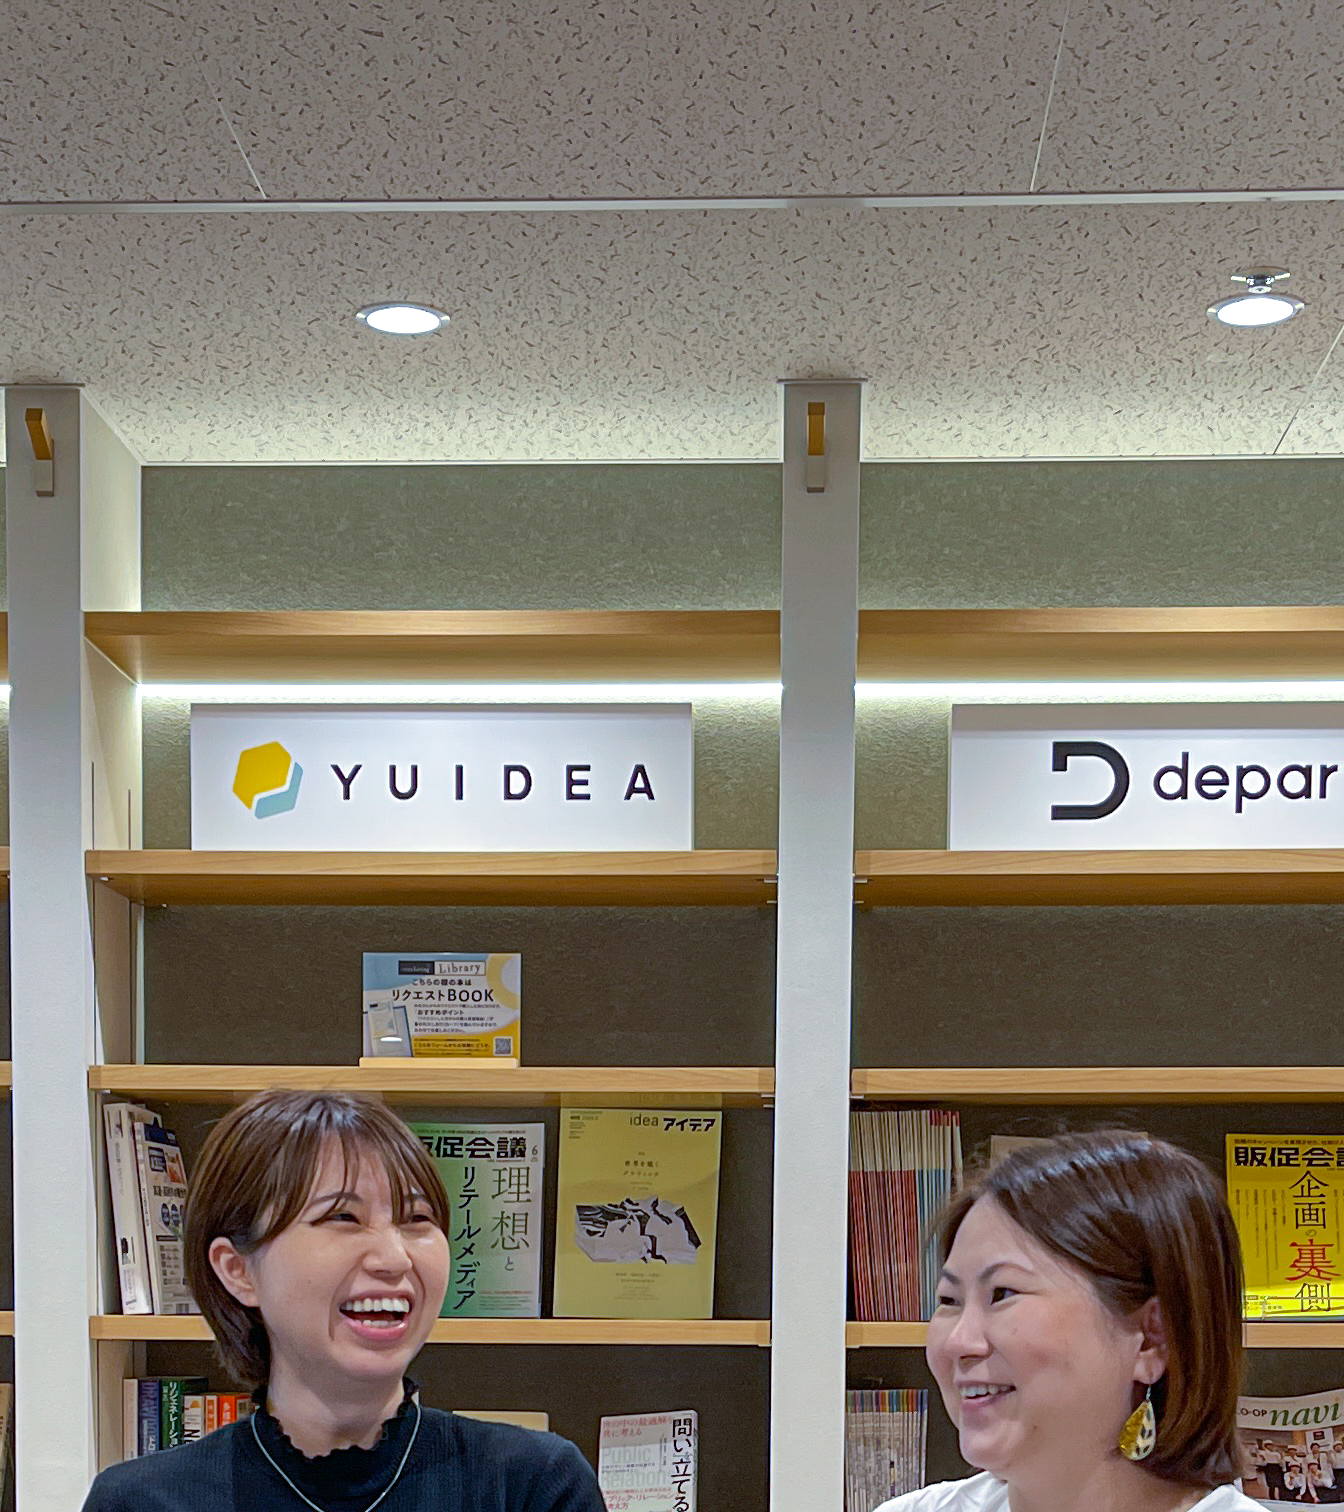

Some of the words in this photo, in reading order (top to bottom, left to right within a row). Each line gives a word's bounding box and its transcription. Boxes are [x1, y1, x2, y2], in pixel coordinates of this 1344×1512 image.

[331, 763, 656, 801] YUIDEA
[439, 962, 481, 974] Library
[392, 988, 494, 1002] リクエストBOOK
[629, 1112, 659, 1126] idea
[663, 1117, 716, 1132] アイデア
[531, 1144, 538, 1156] 6
[490, 1166, 532, 1272] 理想と
[453, 1166, 482, 1310] リテールメディア
[1284, 1170, 1342, 1313] 企画の裏側
[1270, 1401, 1341, 1427] navi
